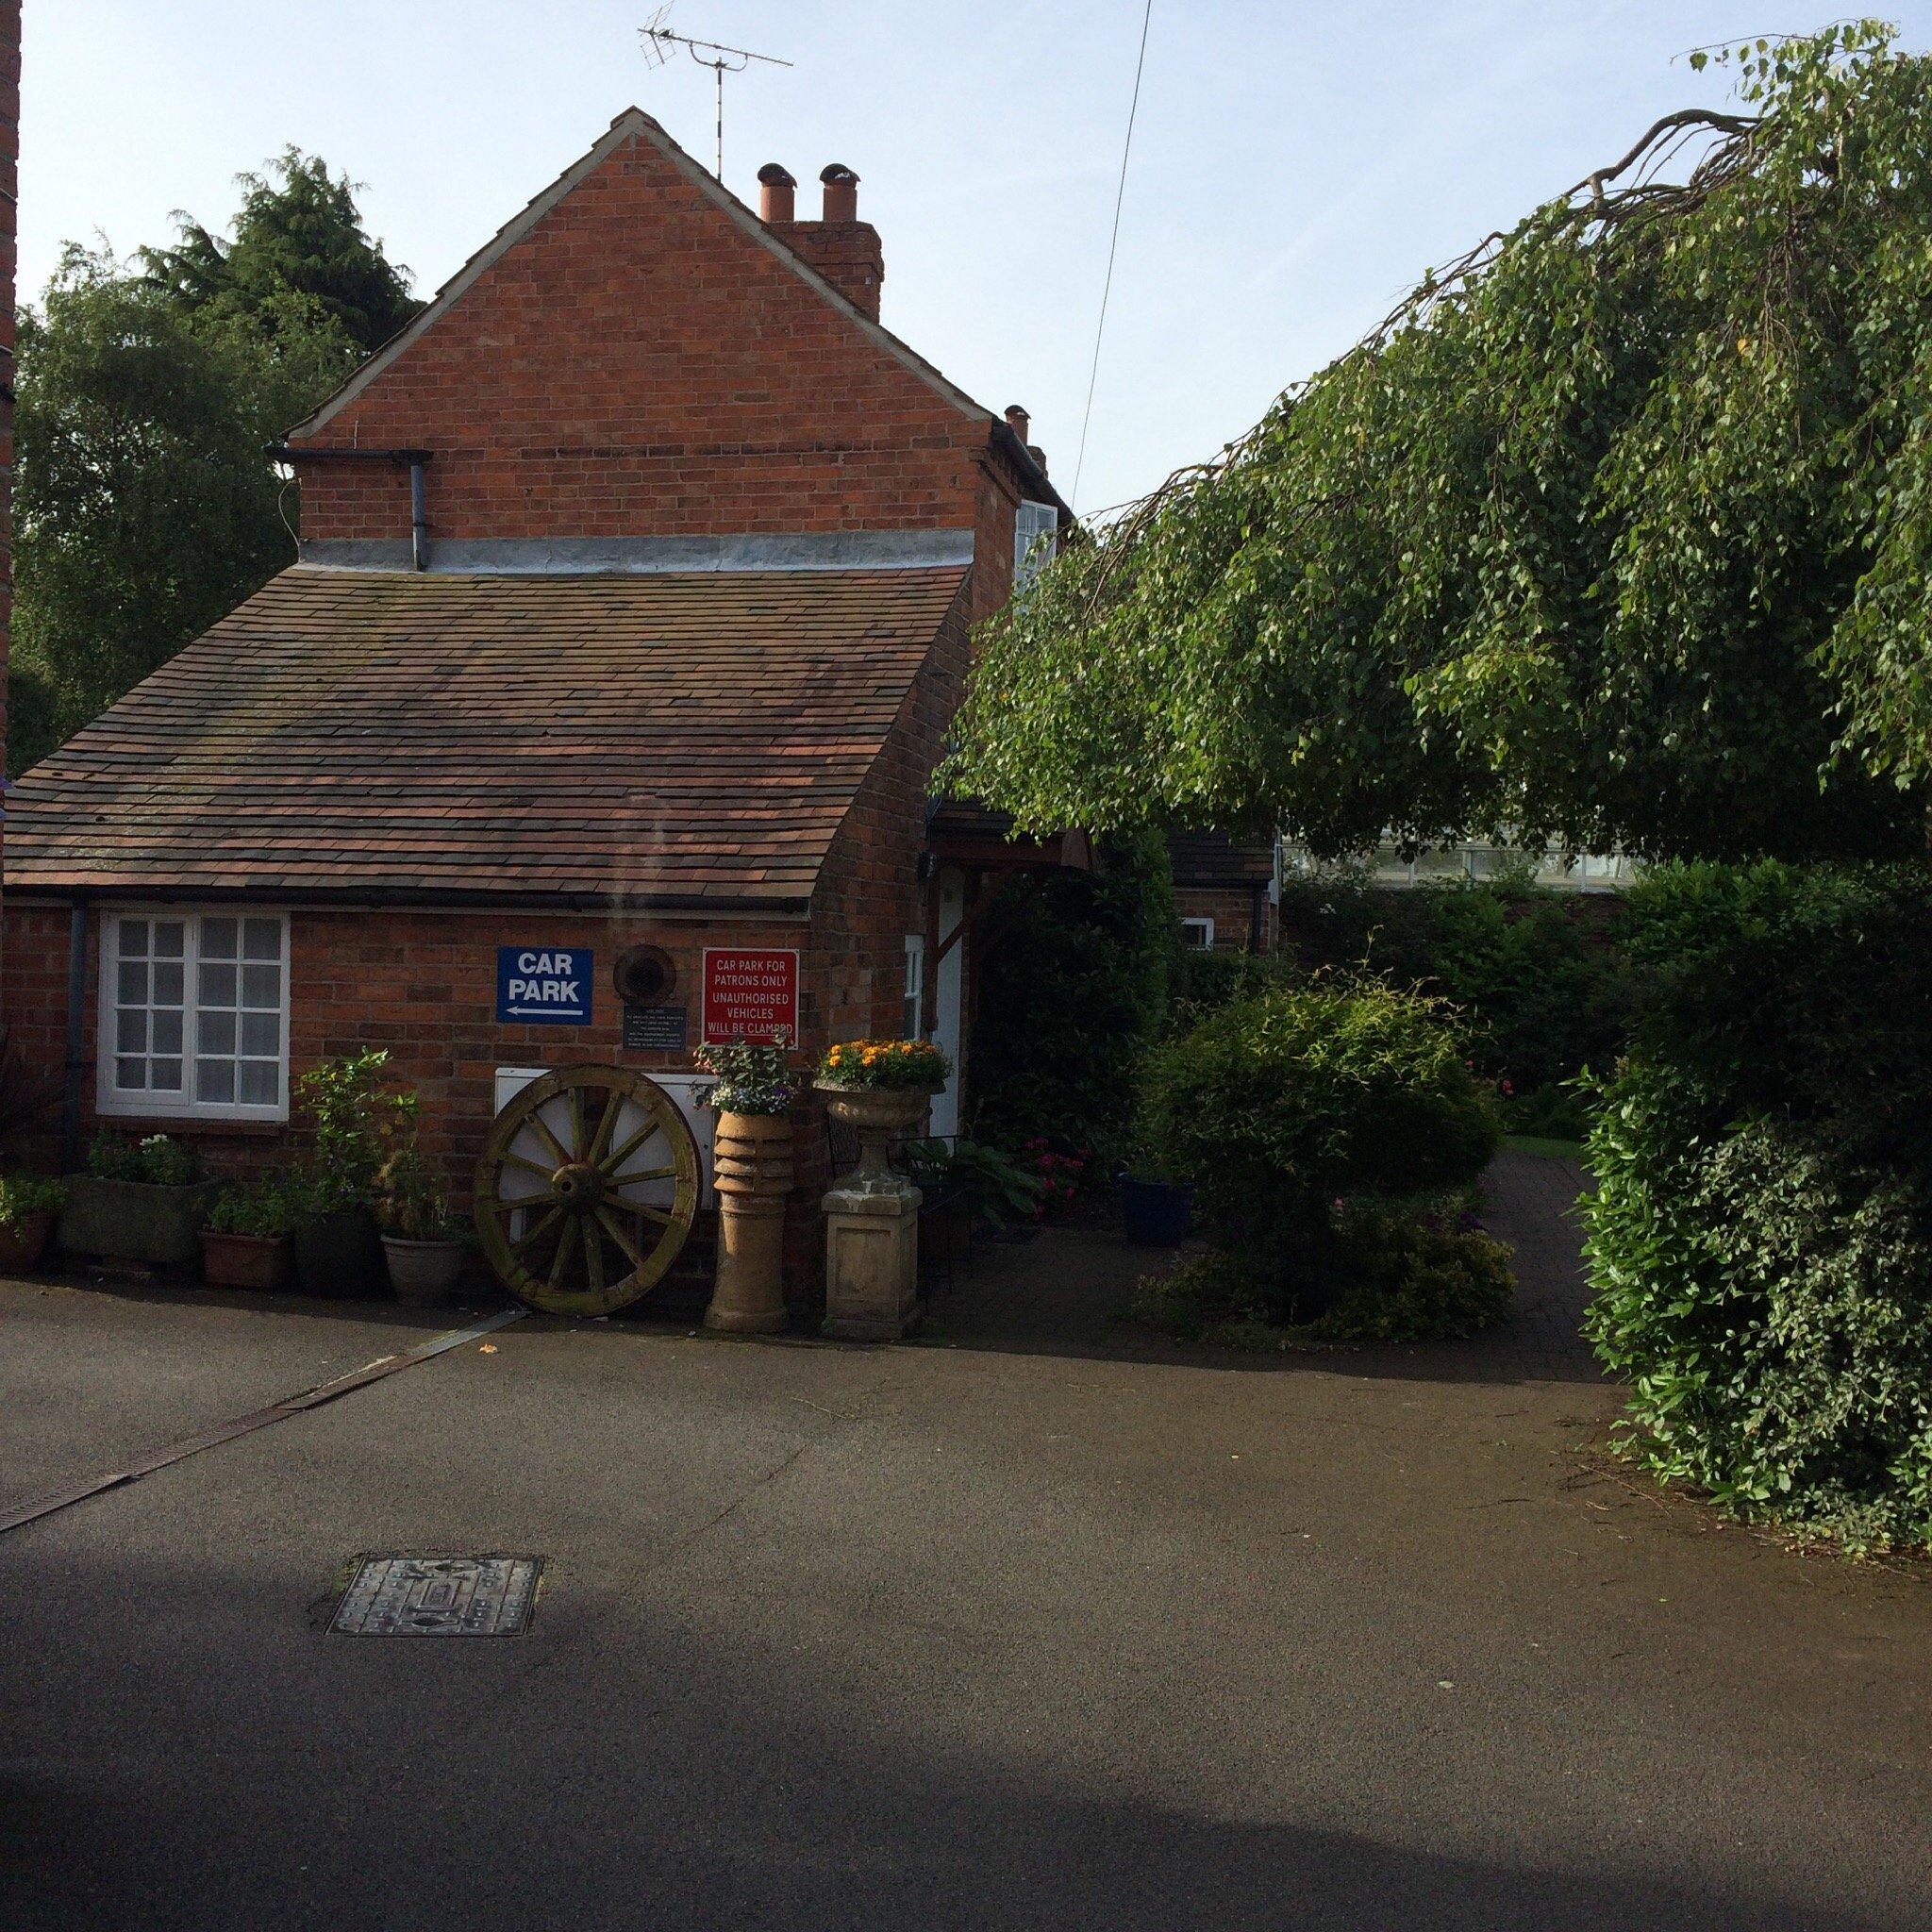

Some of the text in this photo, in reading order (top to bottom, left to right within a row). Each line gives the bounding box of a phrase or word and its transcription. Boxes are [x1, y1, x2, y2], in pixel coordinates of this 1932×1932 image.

[518, 953, 573, 974] CAR
[717, 959, 786, 972] CAR PARK FOR
[714, 974, 788, 987] PATRONS ONLY
[508, 979, 580, 1003] PARK
[712, 991, 789, 1005] UNAUTHORISED
[727, 1008, 774, 1019] VEHICLES
[708, 1022, 793, 1034] WILL BE CLAMD
